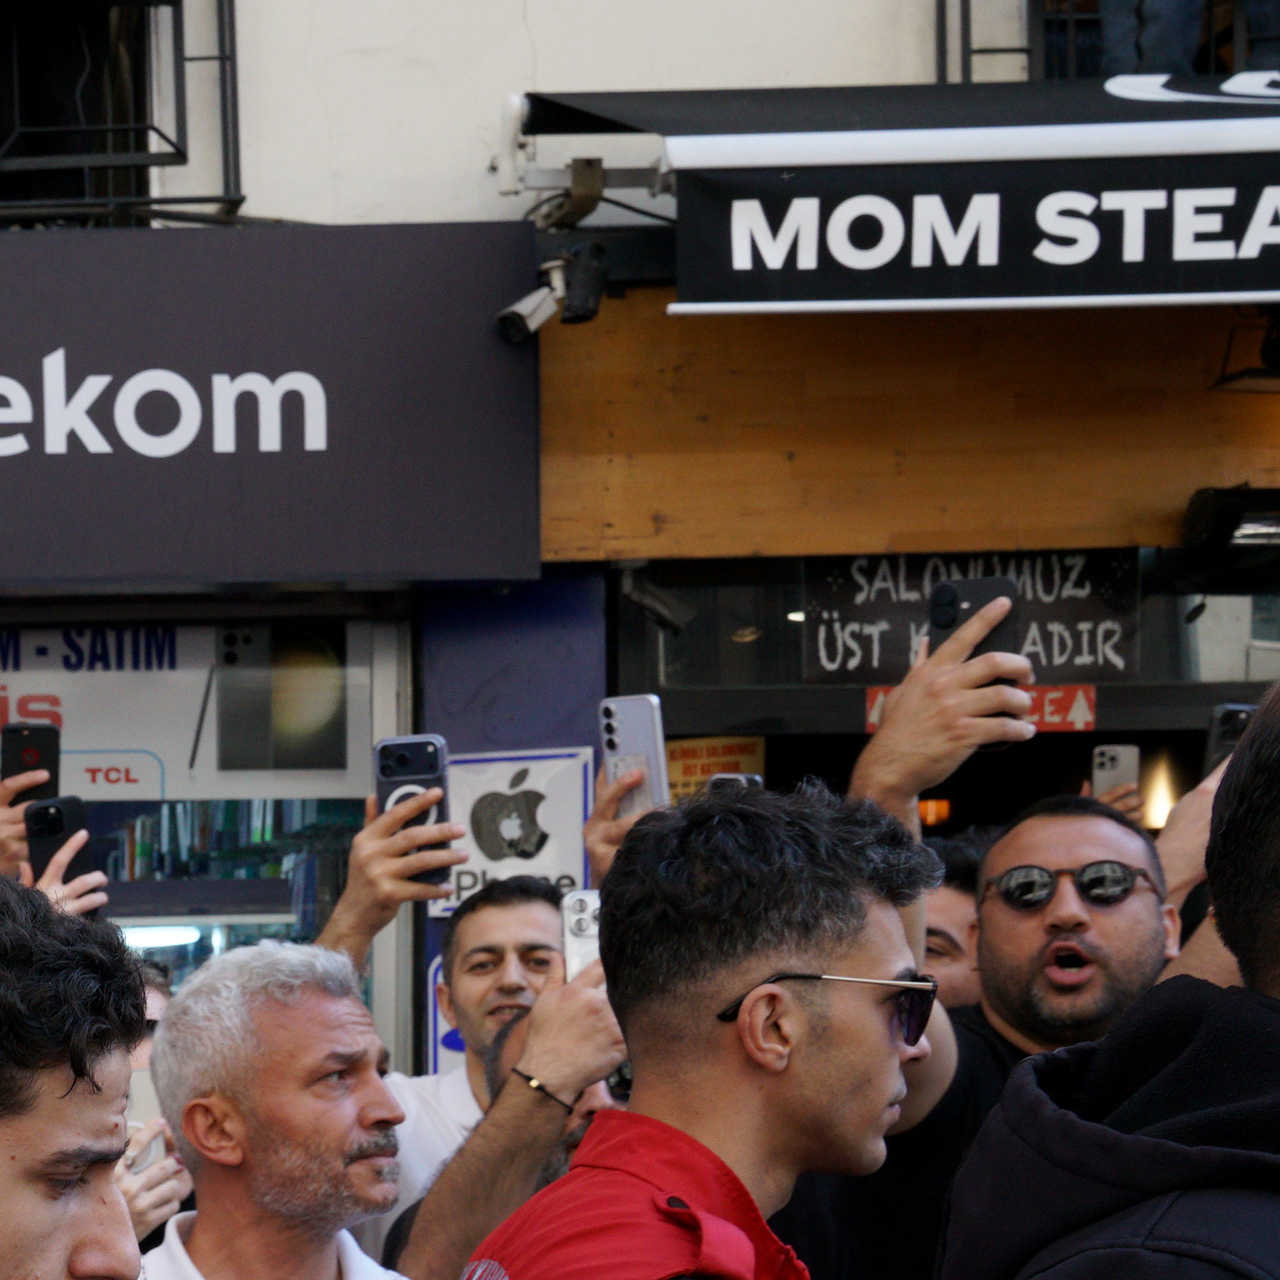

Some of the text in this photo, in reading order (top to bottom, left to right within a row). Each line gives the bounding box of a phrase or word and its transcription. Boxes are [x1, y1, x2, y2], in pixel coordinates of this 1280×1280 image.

[730, 185, 1280, 271] MOM STEA
[61, 627, 177, 672] SATIM
[817, 610, 890, 672] ÜST
[84, 766, 139, 784] TCL
